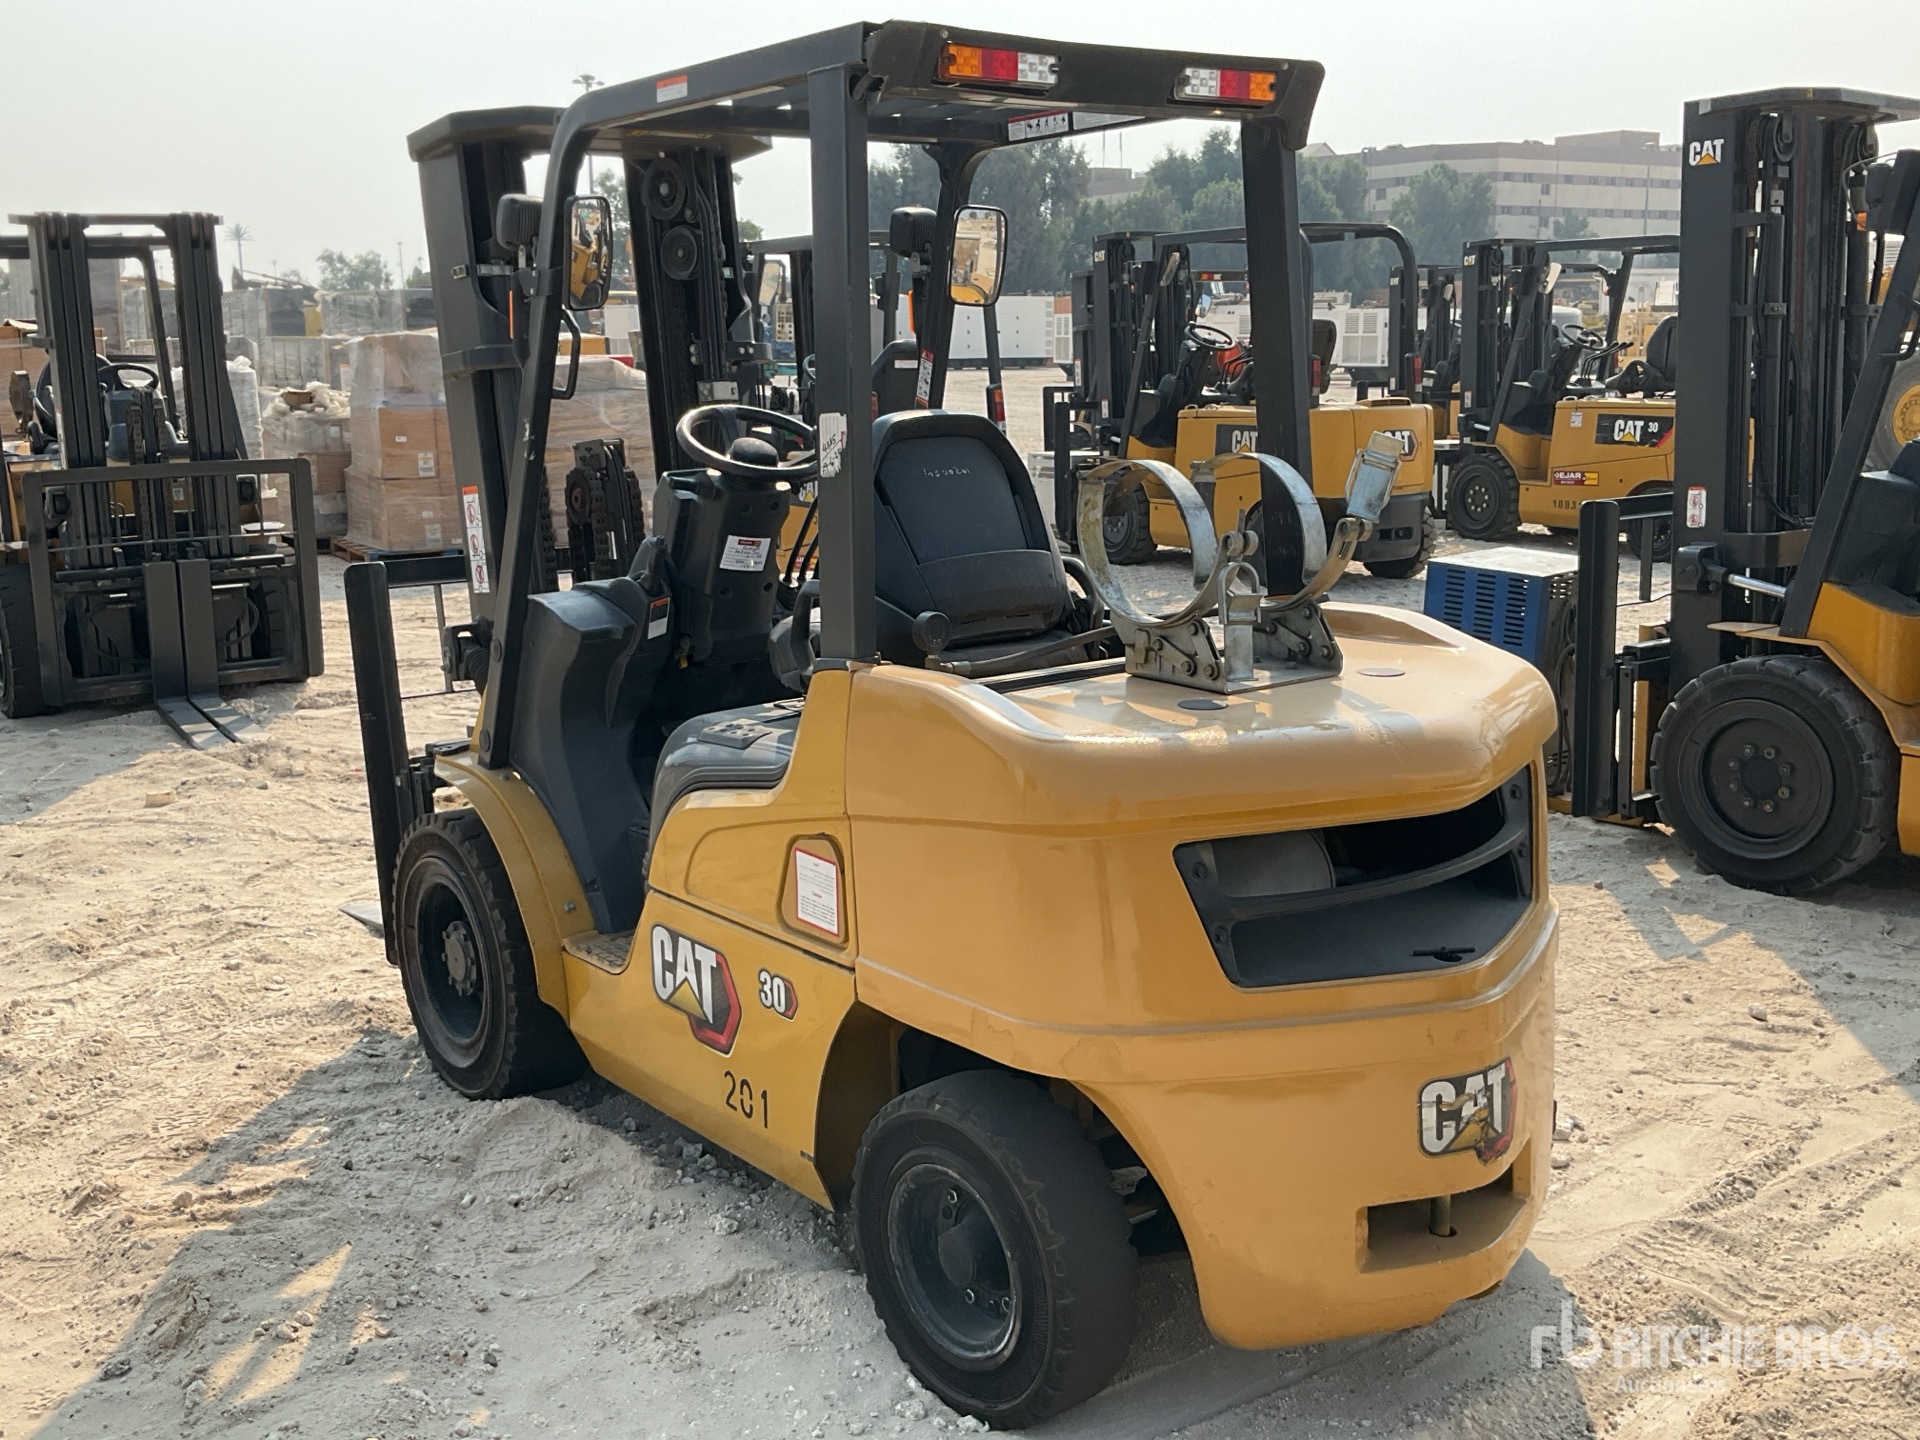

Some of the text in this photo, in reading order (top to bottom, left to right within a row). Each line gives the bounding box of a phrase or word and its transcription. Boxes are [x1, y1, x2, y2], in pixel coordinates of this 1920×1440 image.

[1689, 139, 1724, 166] CAT
[1231, 430, 1258, 453] CAT
[1614, 420, 1659, 442] CAT 30
[652, 925, 717, 1024] CAT
[759, 970, 786, 1014] 30
[724, 1071, 768, 1128] 201
[1422, 1062, 1506, 1153] CAT
